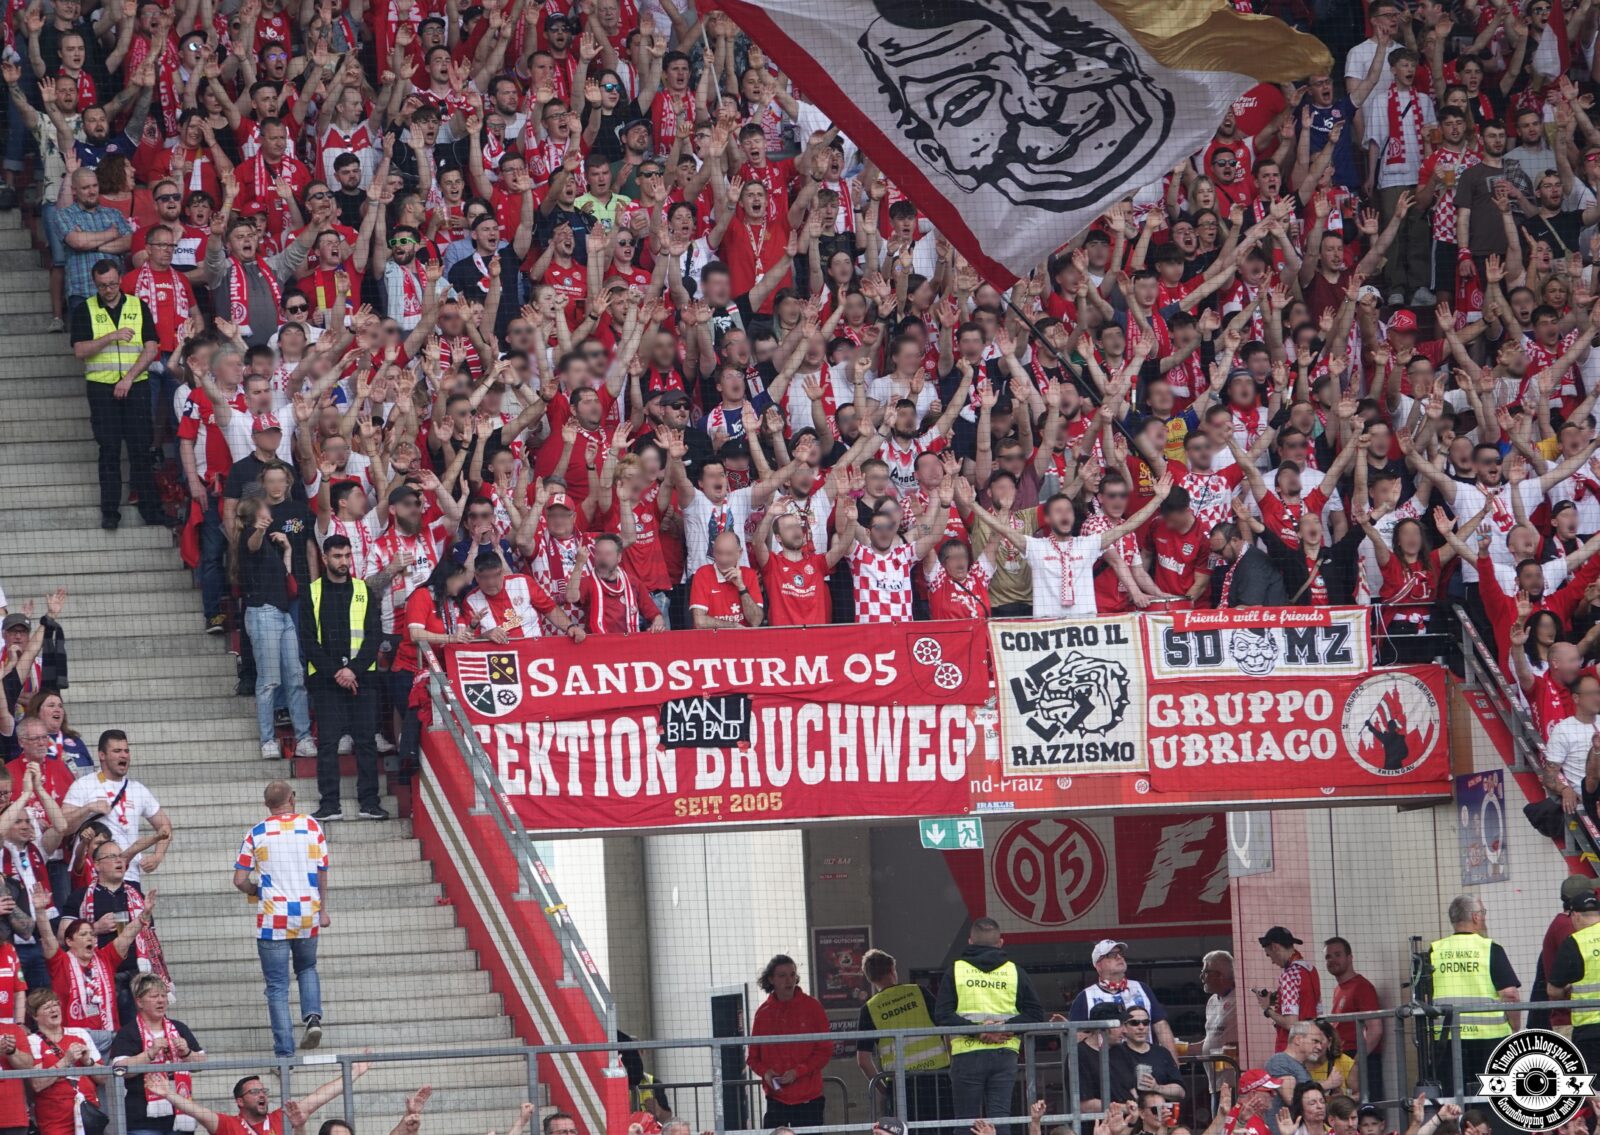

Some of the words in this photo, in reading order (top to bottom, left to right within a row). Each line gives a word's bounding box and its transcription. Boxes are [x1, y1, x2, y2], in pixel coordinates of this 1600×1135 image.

[123, 313, 137, 321] 147
[1184, 612, 1229, 627] friends
[1233, 611, 1259, 623] will
[1262, 610, 1277, 622] be
[1279, 609, 1325, 624] friends
[1001, 625, 1099, 651] CONTRO
[1104, 624, 1129, 645] IL
[1163, 627, 1224, 667] SD
[1282, 622, 1354, 666] MZ
[527, 655, 833, 697] SANDSTURM
[843, 650, 897, 686] 05
[1345, 684, 1364, 713] GRUPPO
[1414, 680, 1436, 708] UBRIACO
[667, 698, 745, 723] MANU
[1149, 688, 1333, 728] GRUPPO
[667, 722, 697, 742] BIS
[703, 720, 740, 740] BALD
[1012, 741, 1135, 766] RAZZISMO
[1150, 728, 1337, 769] UBRIACO
[674, 795, 723, 816] SEIT
[729, 792, 783, 813] 2005
[1440, 962, 1479, 973] ORDNER
[966, 979, 1007, 990] ORDNER
[881, 1001, 919, 1021] ORDNER
